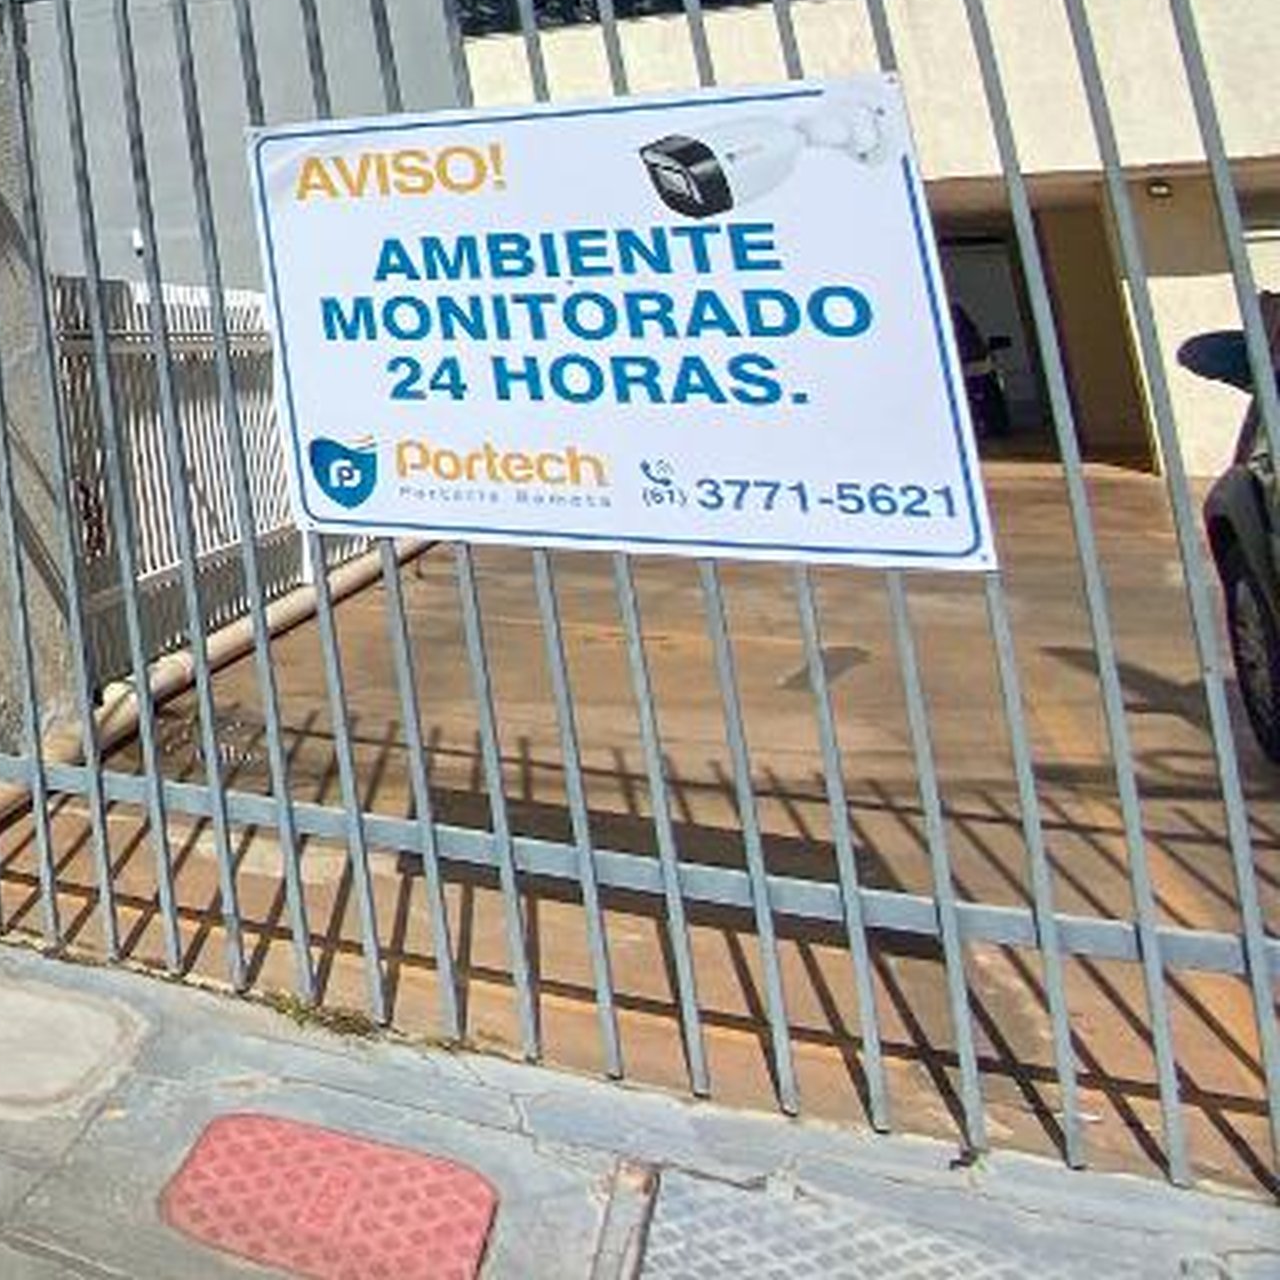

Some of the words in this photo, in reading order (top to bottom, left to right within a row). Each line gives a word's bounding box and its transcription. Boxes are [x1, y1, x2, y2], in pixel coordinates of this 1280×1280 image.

[295, 143, 508, 201] AVISO!
[373, 222, 784, 282] AMBIENTE
[321, 285, 874, 341] MONITORADO
[386, 357, 467, 402] 24
[494, 353, 810, 406] HORAS.
[396, 439, 608, 485] Portech
[641, 486, 688, 507] (61)
[695, 478, 956, 518] 3771-5621
